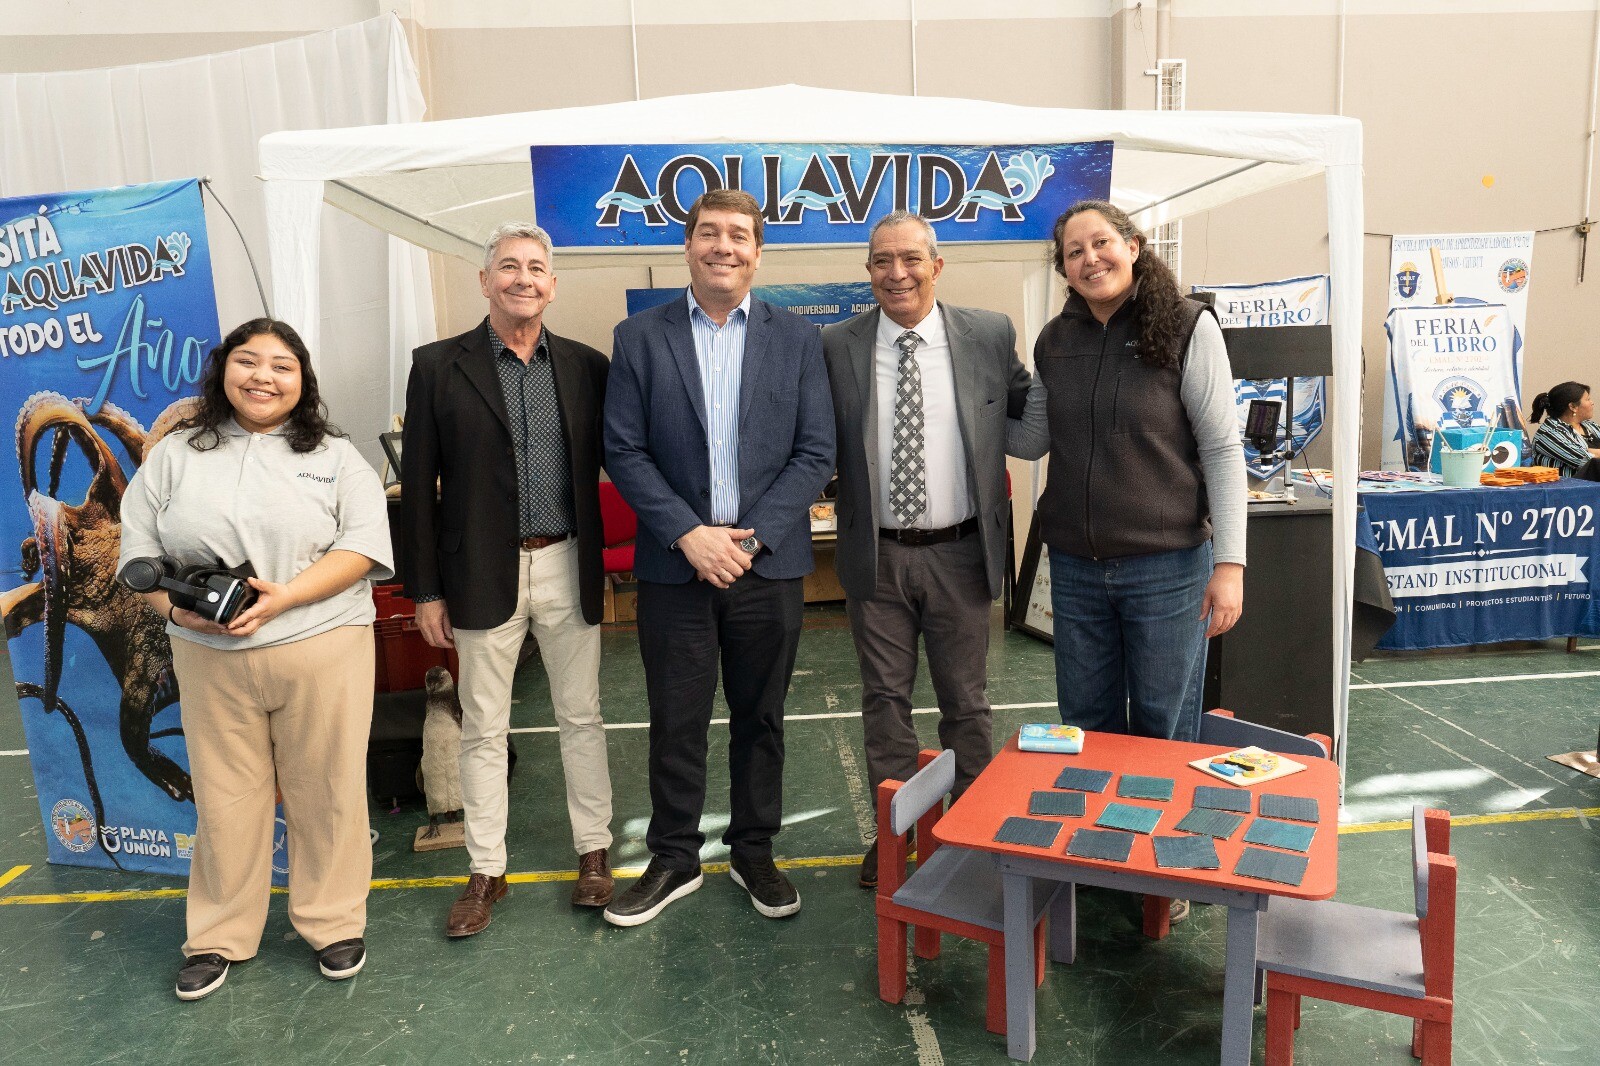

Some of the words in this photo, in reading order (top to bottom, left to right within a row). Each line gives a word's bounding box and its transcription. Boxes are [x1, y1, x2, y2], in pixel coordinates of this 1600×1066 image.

[596, 151, 1027, 226] AQUAVIDA
[2, 235, 186, 314] AQUAVIDA
[1228, 297, 1288, 314] FERIA
[1221, 317, 1242, 325] DEL
[1246, 307, 1311, 328] LIBRO
[1415, 317, 1482, 336] FERIA
[0, 317, 64, 358] TODO
[66, 312, 103, 344] EL
[1410, 339, 1429, 347] DEL
[1433, 335, 1497, 353] LIBRO
[76, 294, 209, 416] Año
[1521, 504, 1595, 541] 2702
[1386, 572, 1438, 590] STAND
[1445, 561, 1567, 586] INSTITUCIONAL
[1415, 602, 1457, 612] COMUNIDAD
[1466, 598, 1503, 607] PROYECTOS
[1505, 594, 1553, 604] ESTUDIANTES
[120, 826, 169, 843] PLAYA
[123, 841, 171, 858] UNIÓN
